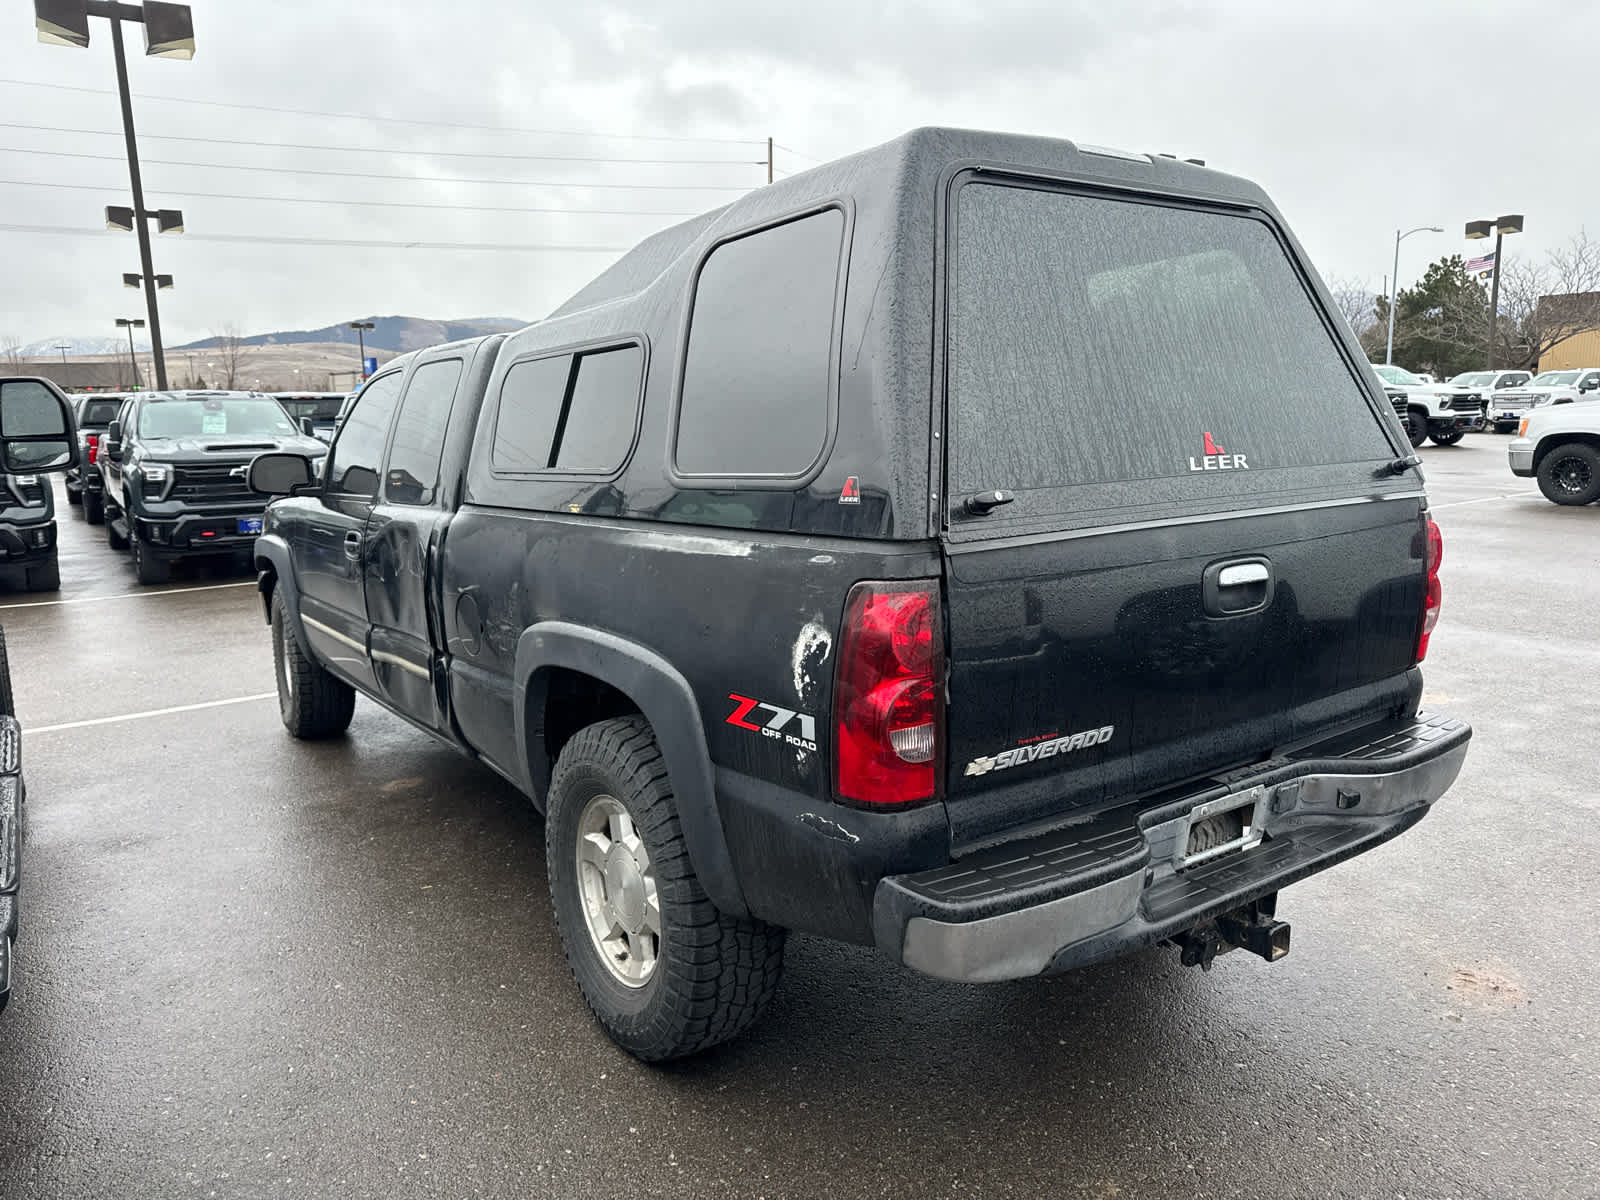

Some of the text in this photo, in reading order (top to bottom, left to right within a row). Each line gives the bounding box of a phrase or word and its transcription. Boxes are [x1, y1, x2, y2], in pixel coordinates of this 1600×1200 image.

[1189, 454, 1249, 471] LEER
[726, 693, 816, 741] Z71
[761, 727, 817, 751] OFF ROAD
[994, 725, 1114, 770] SILVERADO
